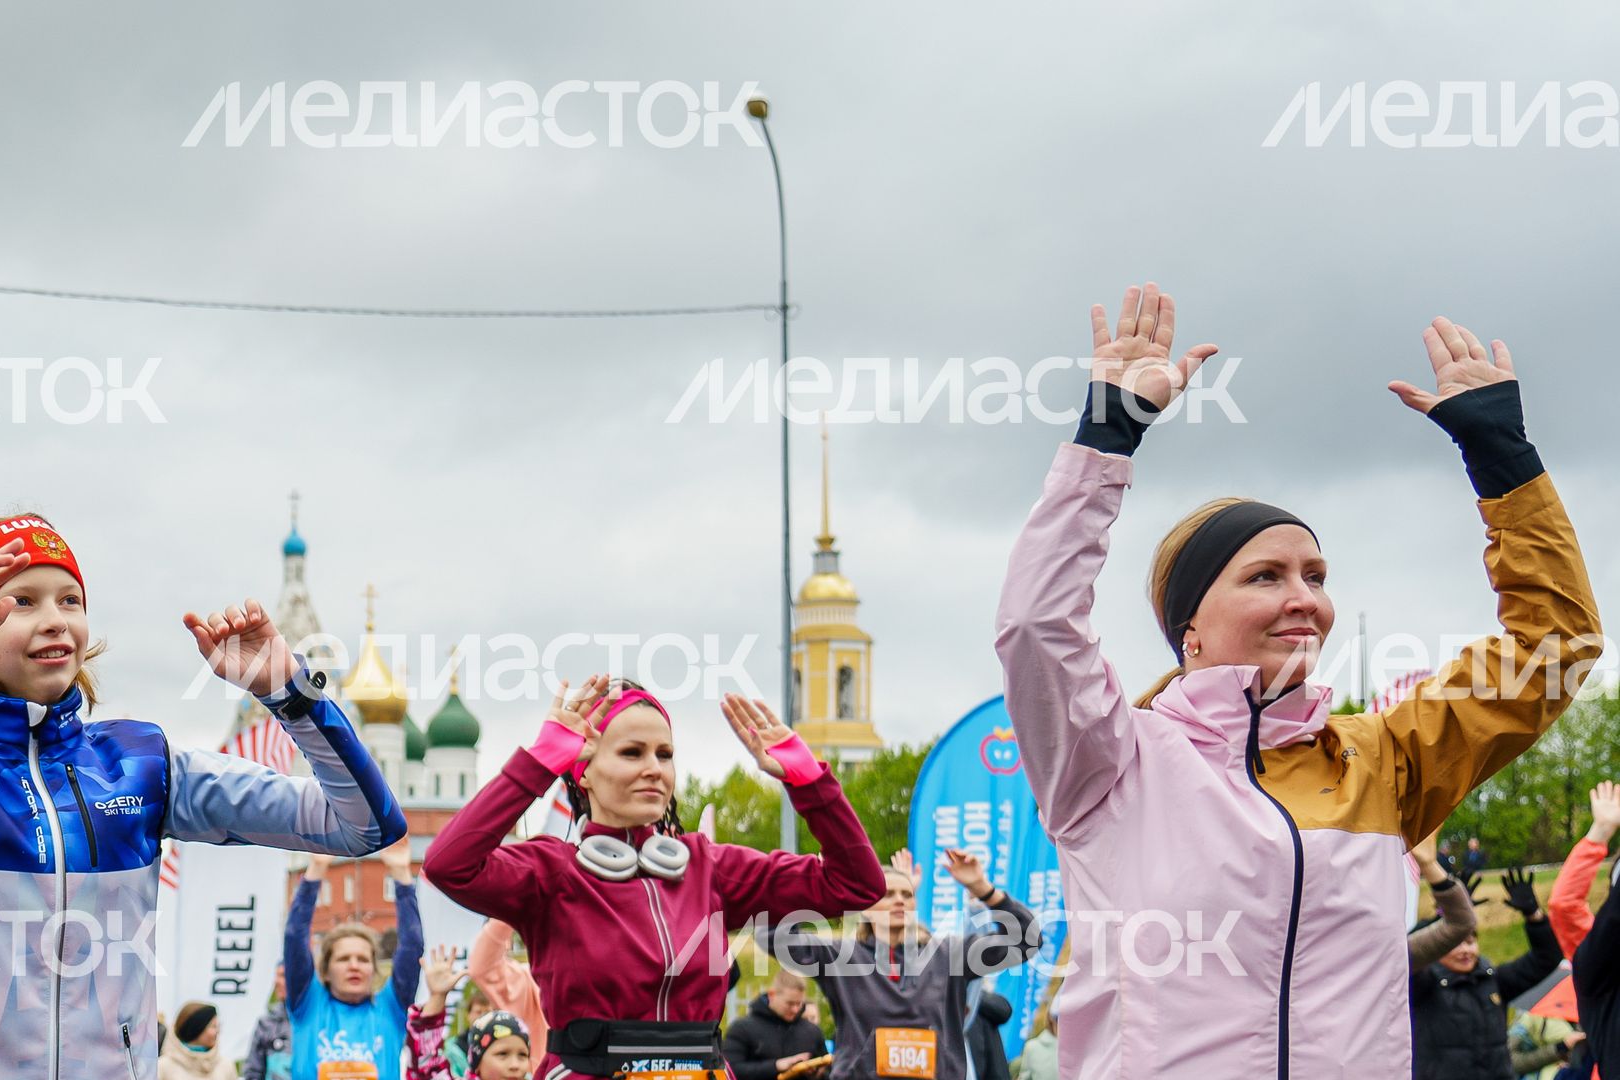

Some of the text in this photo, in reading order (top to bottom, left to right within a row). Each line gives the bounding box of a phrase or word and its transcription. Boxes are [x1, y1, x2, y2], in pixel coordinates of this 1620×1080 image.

[94, 796, 143, 809] OZERY
[36, 826, 46, 864] CODE
[888, 1046, 927, 1070] 5194
